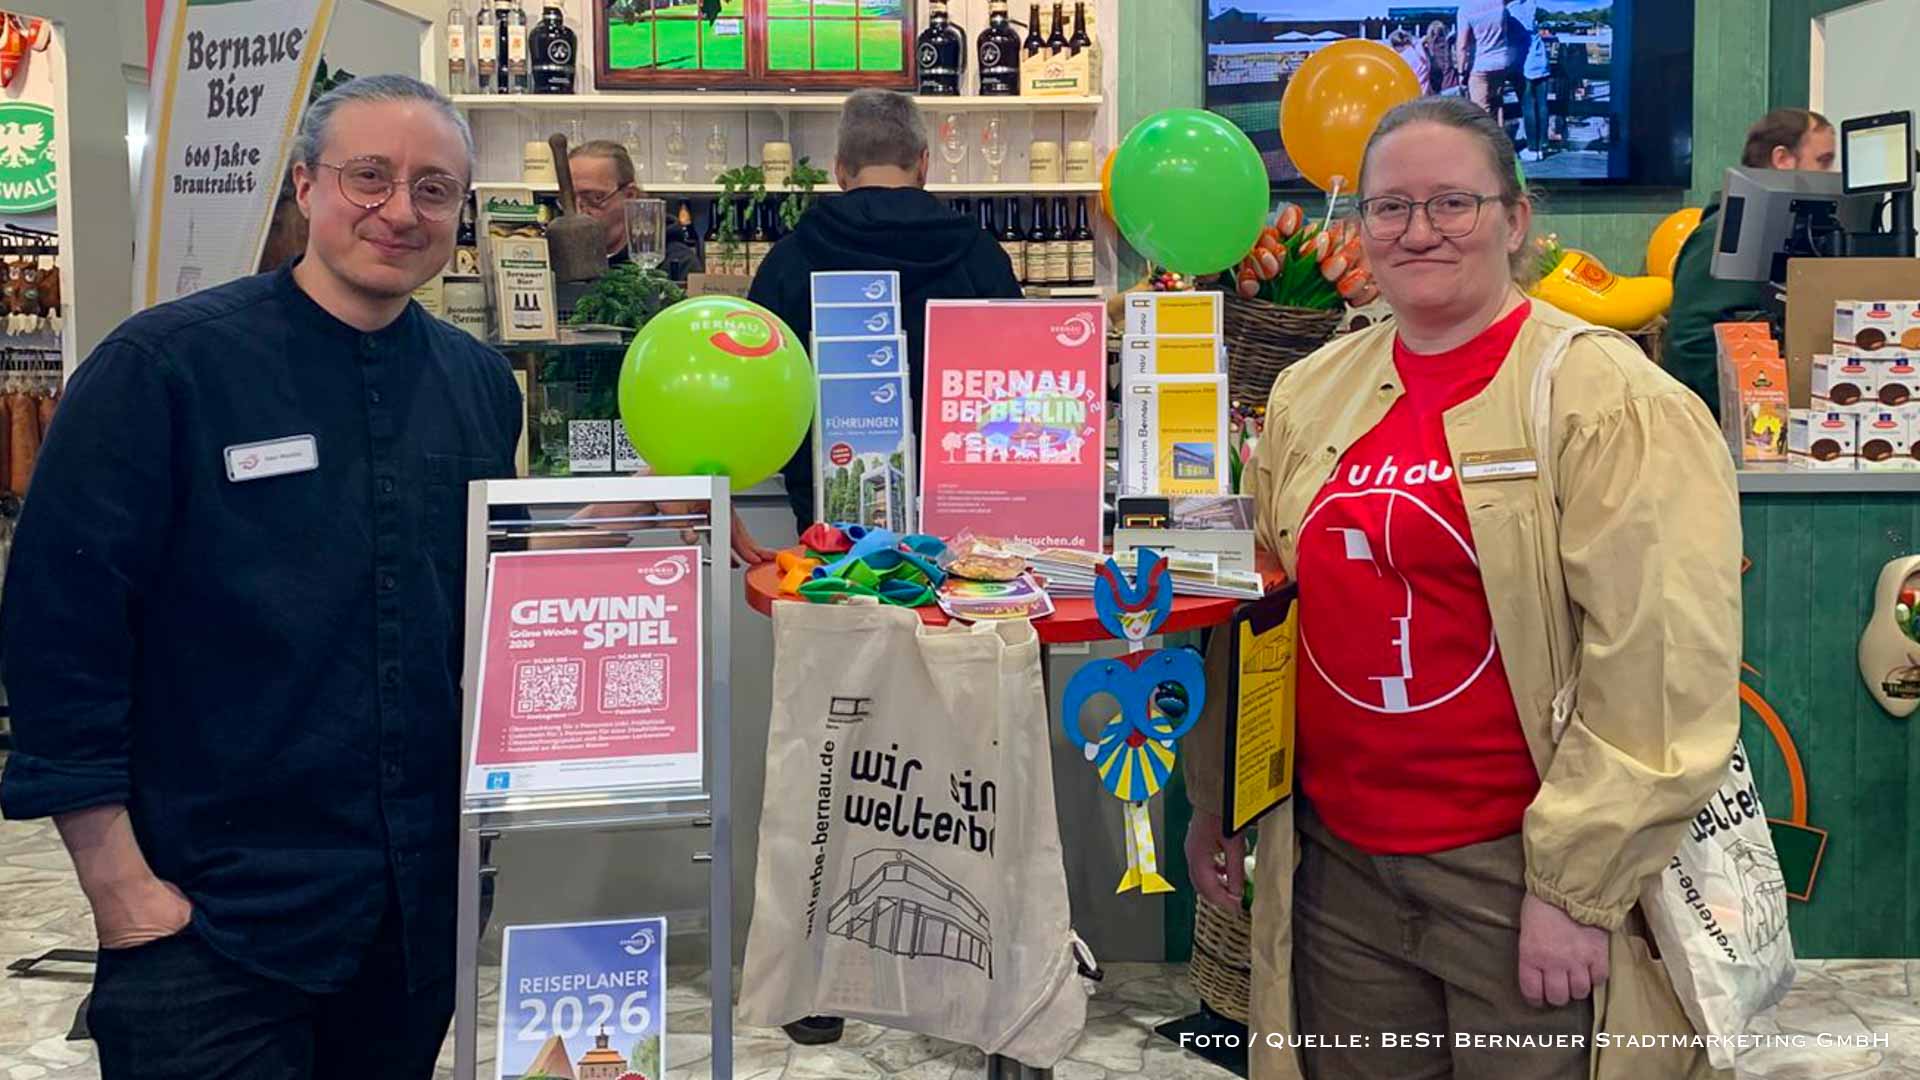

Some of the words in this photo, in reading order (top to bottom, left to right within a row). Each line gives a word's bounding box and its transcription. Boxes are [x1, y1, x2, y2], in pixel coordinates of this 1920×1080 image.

[187, 27, 307, 71] Bernaue
[207, 72, 265, 119] Bier
[185, 144, 211, 167] 600
[213, 142, 261, 172] Jahre
[2, 171, 57, 200] WALD
[690, 319, 760, 333] BERNAU
[941, 369, 1086, 397] BERNAU
[825, 416, 899, 429] FÜHRUNGEN
[990, 400, 1086, 423] BERLIN
[1138, 399, 1148, 437] Bernau
[511, 595, 679, 625] GEWINN-
[508, 640, 535, 649] 2026
[509, 628, 542, 639] Grüne
[543, 626, 578, 637] Woche
[583, 620, 678, 650] SPIEL
[850, 743, 923, 792] wir
[519, 970, 649, 993] REISEPLANER
[517, 990, 651, 1041] 2026
